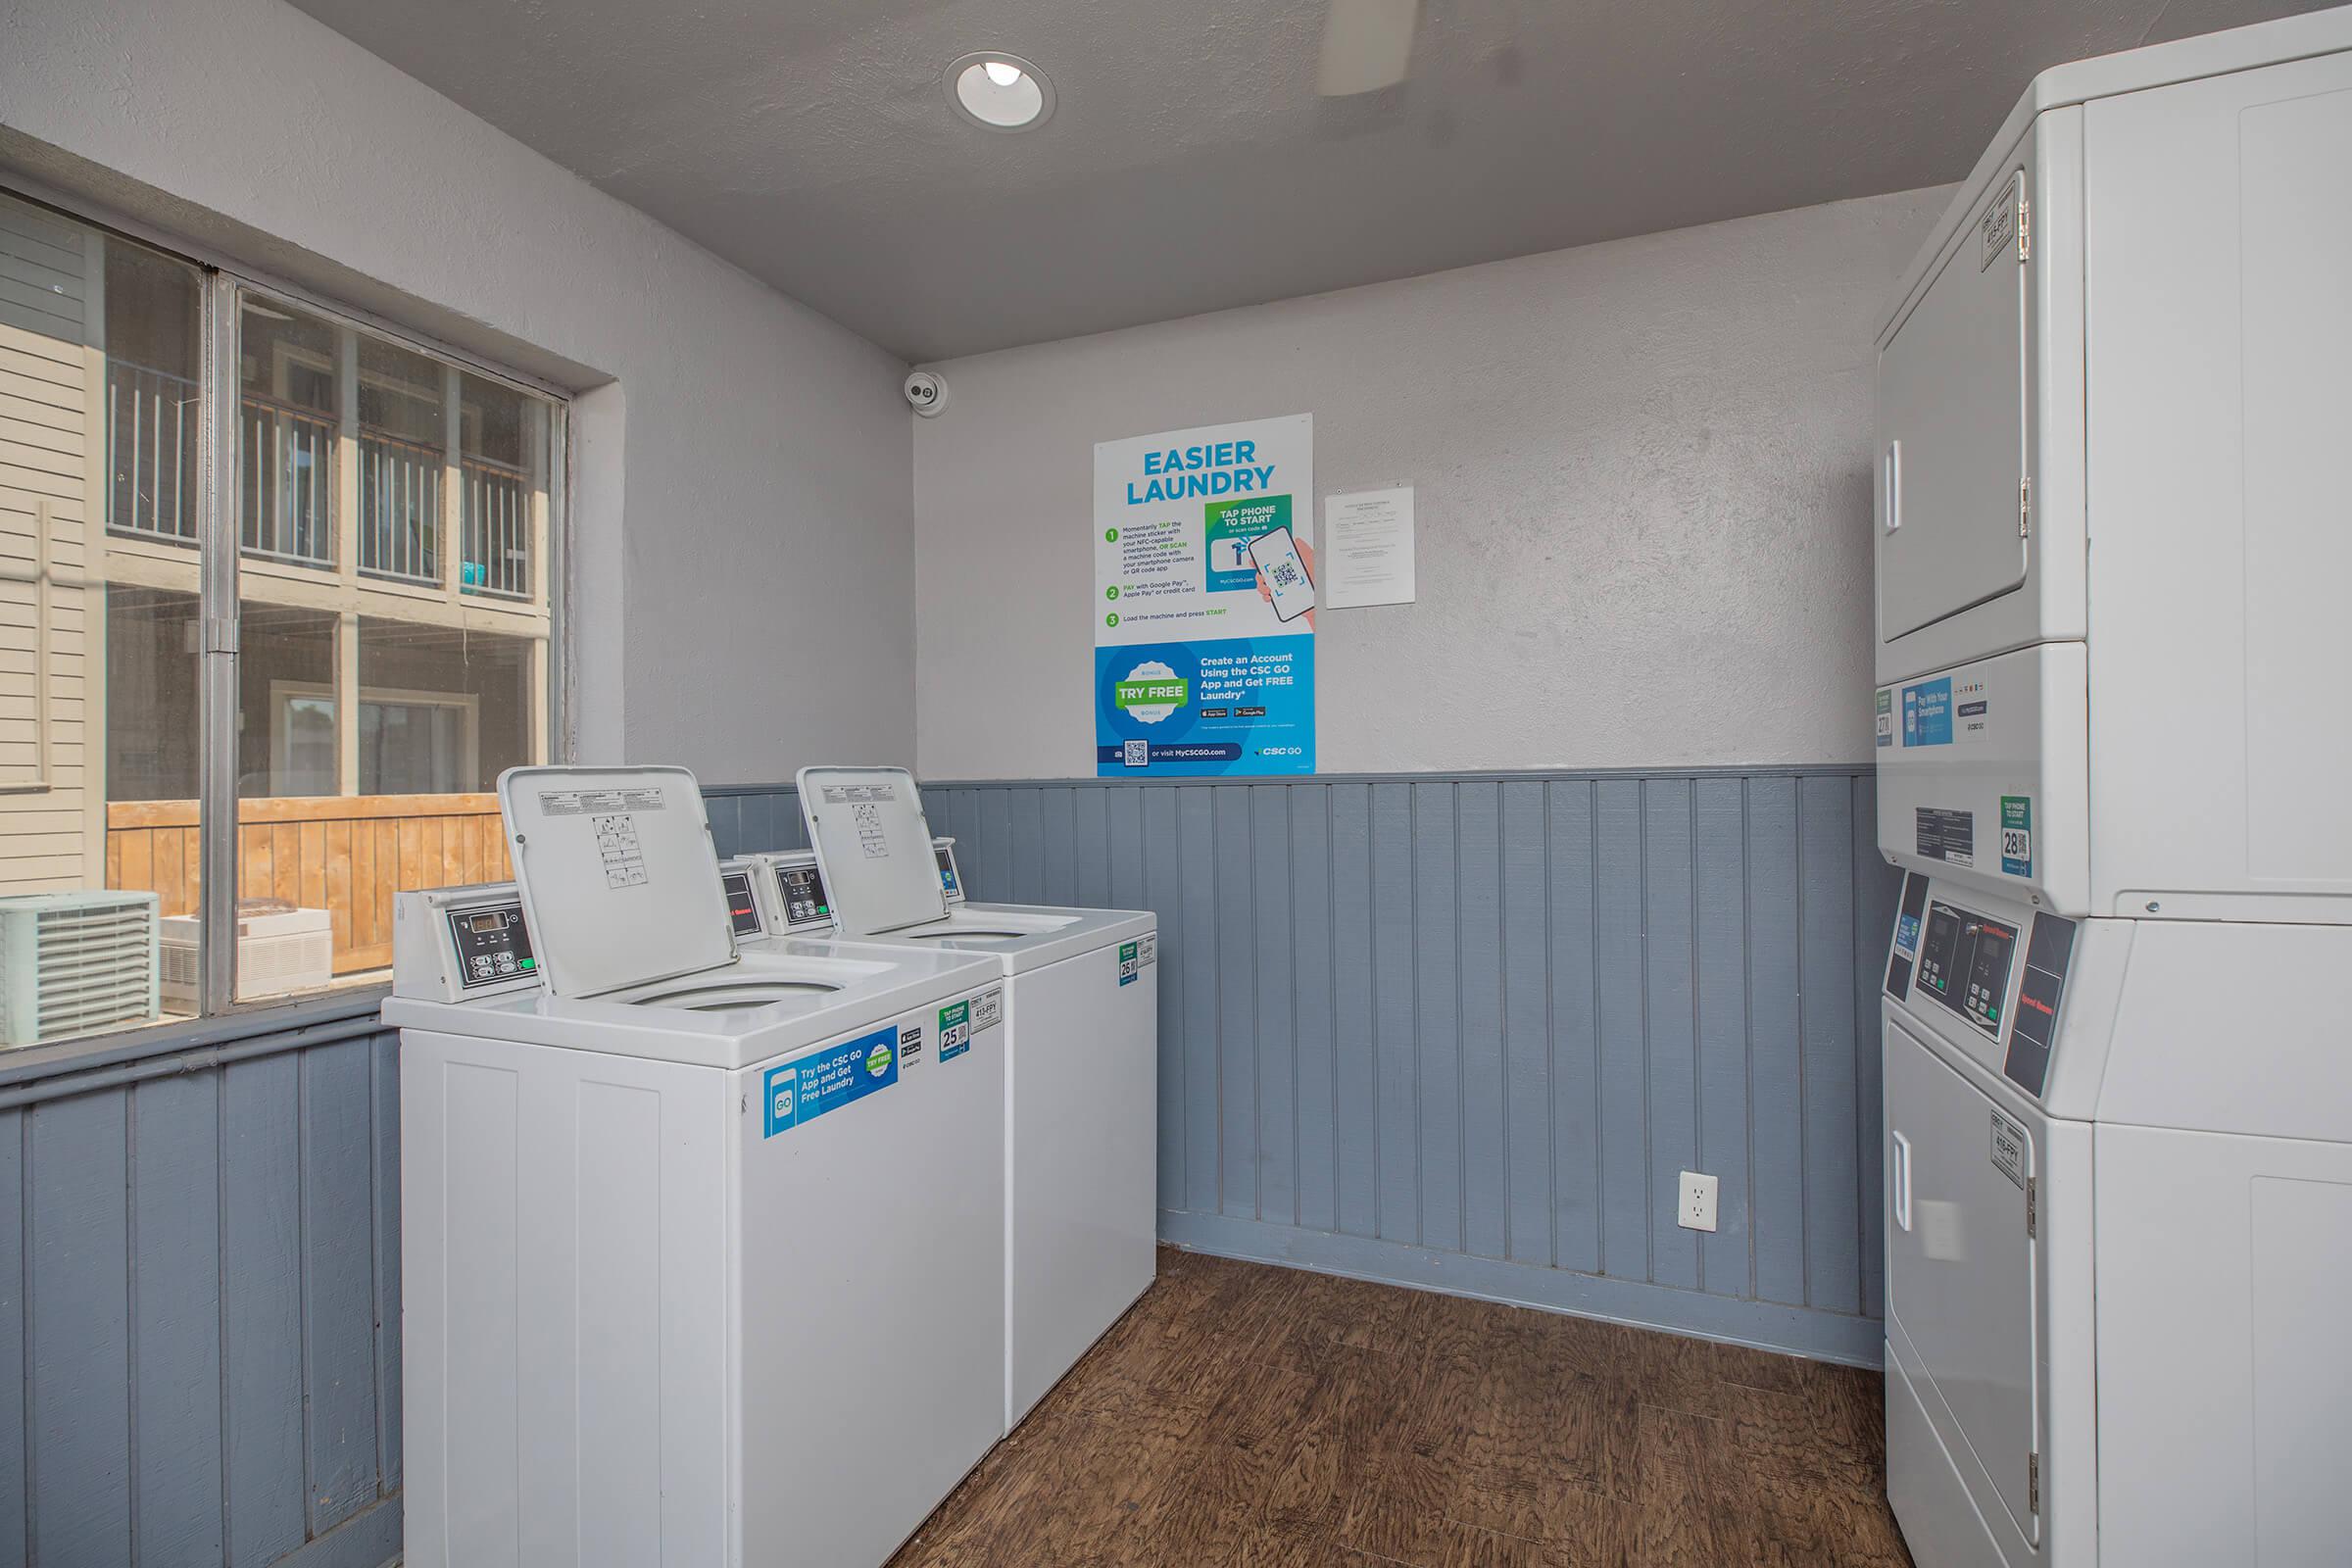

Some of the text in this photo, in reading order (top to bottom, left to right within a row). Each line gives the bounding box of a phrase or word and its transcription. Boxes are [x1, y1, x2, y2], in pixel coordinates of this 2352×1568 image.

[1144, 440, 1255, 475] EASIER
[1127, 465, 1276, 505] LAUNDRY
[1219, 506, 1276, 518] TAP PHONE
[1224, 514, 1272, 526] TO START
[1123, 523, 1157, 532] Momentarily
[1109, 589, 1115, 598] 2
[1110, 615, 1115, 625] 3
[1200, 658, 1233, 666] Create
[1250, 653, 1294, 663] Account
[1200, 664, 1290, 678] Using the CSC GO
[1200, 676, 1294, 690] App and Get FREE
[1119, 685, 1184, 699] TRY FREE
[1262, 747, 1287, 756] CSC
[2005, 832, 2017, 855] 28
[1121, 962, 1131, 976] 26
[943, 1028, 956, 1049] 25
[801, 1067, 815, 1079] Try
[817, 1062, 831, 1074] the
[832, 1054, 849, 1067] CSC
[849, 1050, 862, 1060] GO
[878, 1054, 890, 1064] FREE
[802, 1064, 851, 1092] App and Get
[802, 1076, 855, 1103] Free Laundry
[776, 1098, 792, 1111] GO
